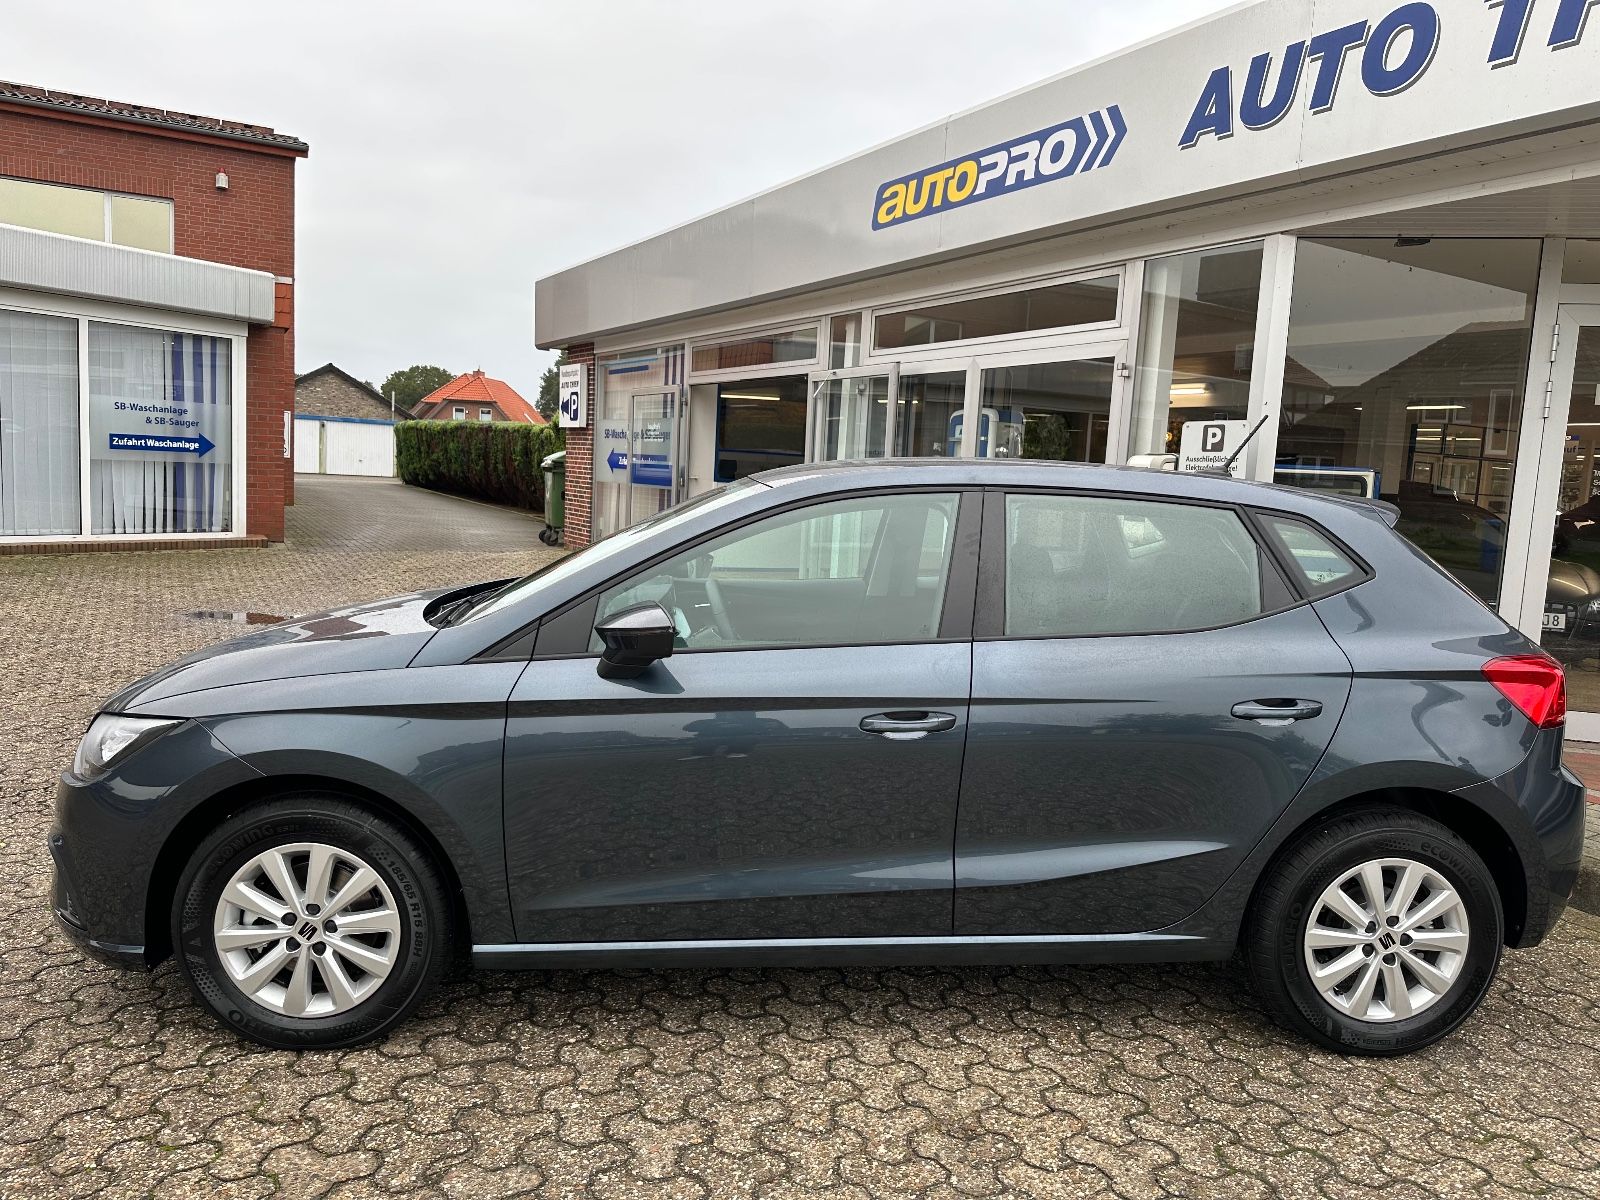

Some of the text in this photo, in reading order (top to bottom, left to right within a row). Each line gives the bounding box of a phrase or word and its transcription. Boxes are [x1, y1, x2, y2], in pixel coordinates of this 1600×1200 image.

[1178, 2, 1441, 151] AUTO
[114, 401, 188, 416] SB-Waschanlage
[145, 416, 200, 428] & SB-Sauger
[112, 437, 200, 450] Zufahrt Waschanlage
